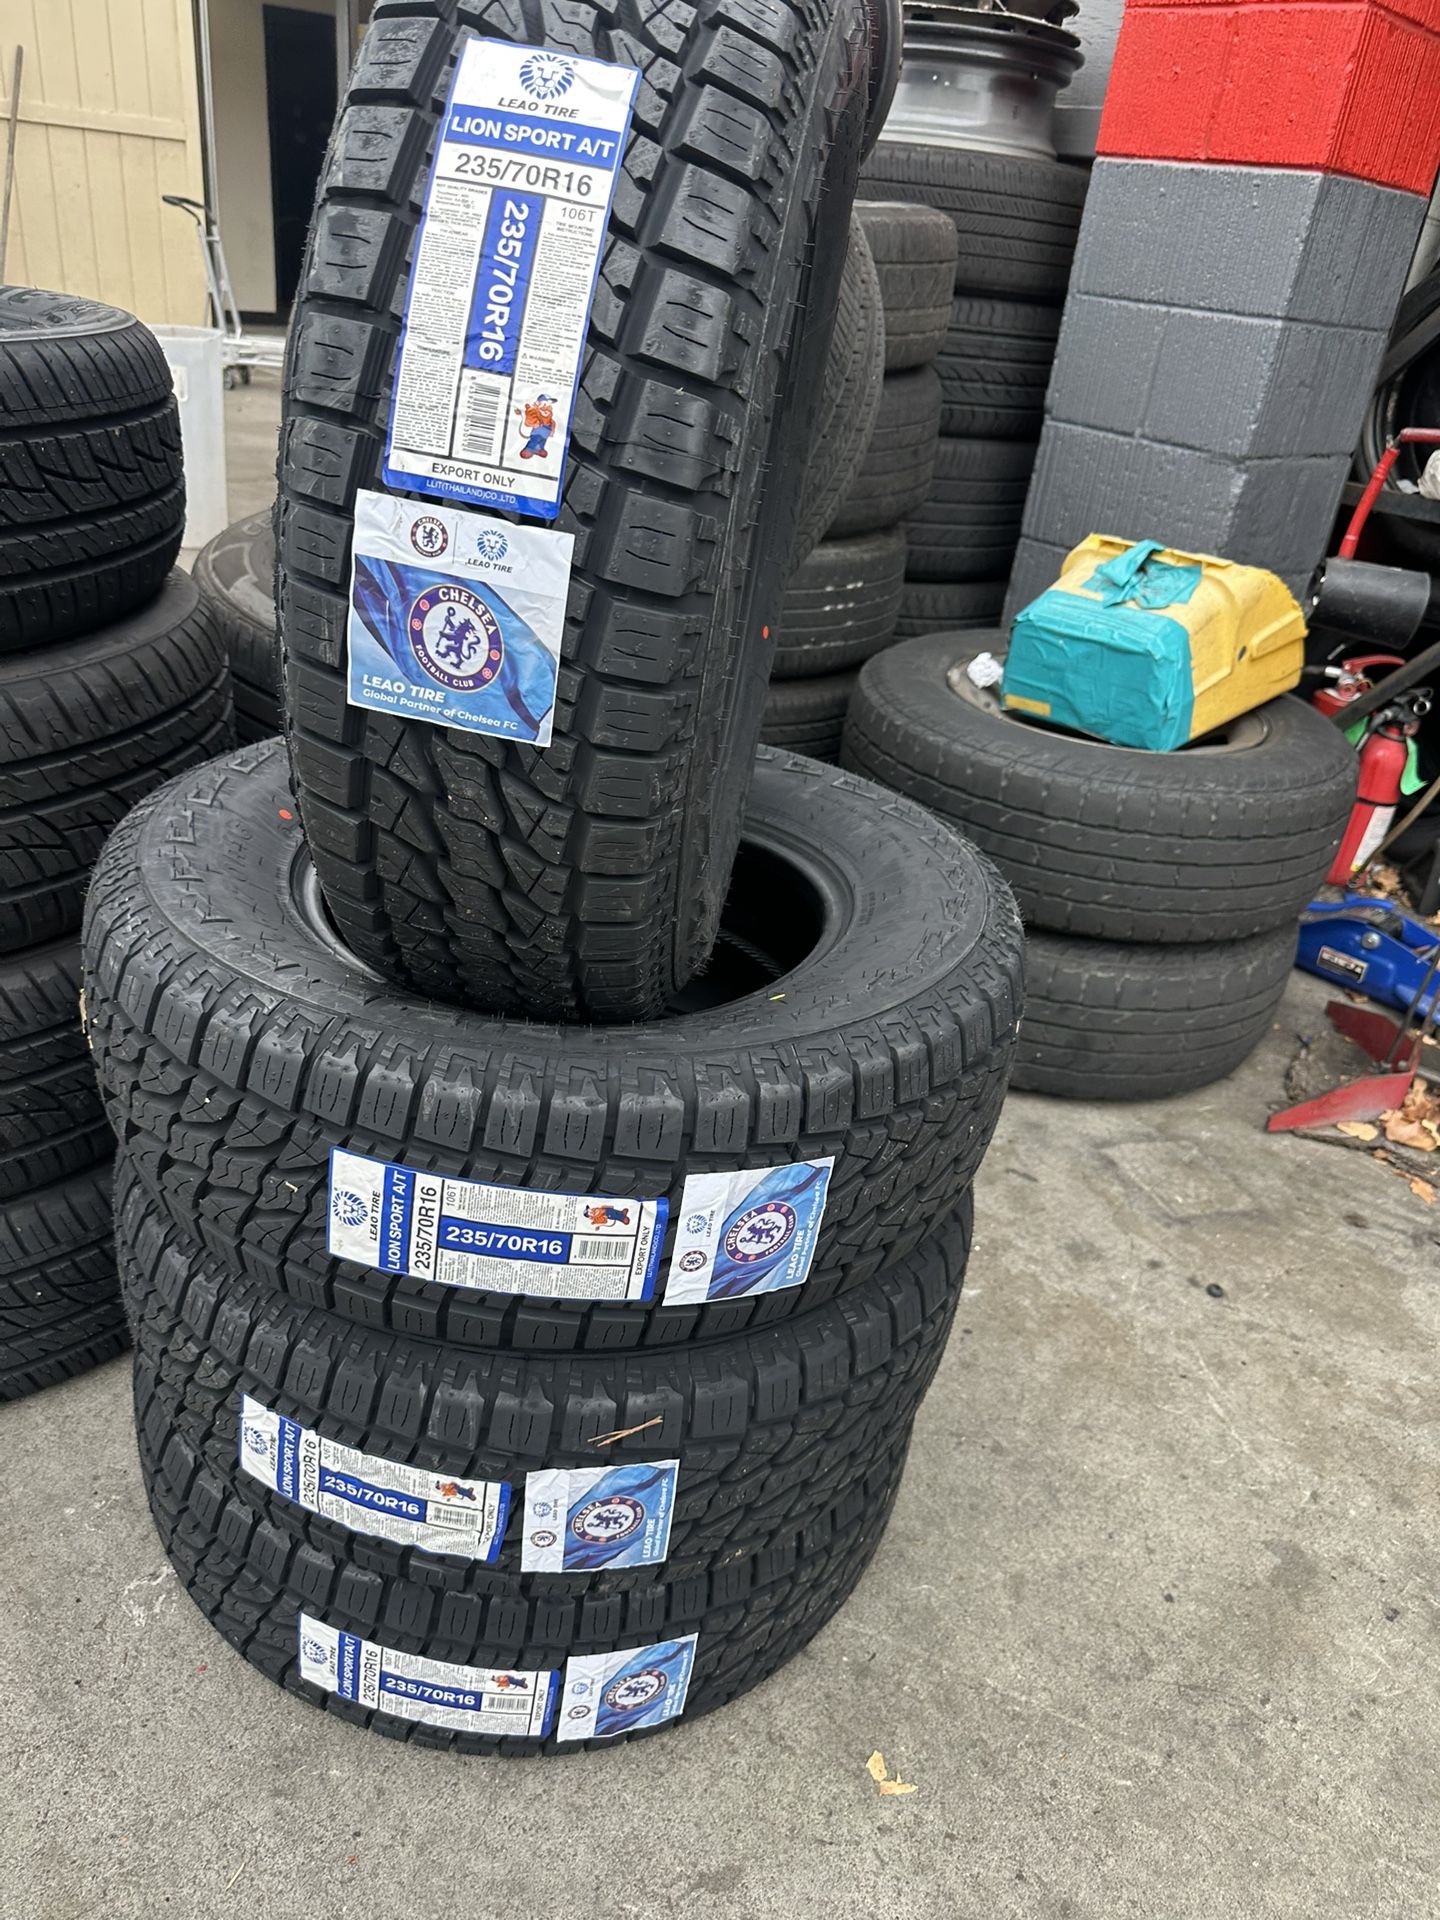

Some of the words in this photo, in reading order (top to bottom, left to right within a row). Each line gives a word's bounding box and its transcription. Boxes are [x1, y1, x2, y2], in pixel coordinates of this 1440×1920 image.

[498, 96, 539, 112] LEAO
[545, 103, 580, 119] TIRE
[451, 115, 502, 140] LION
[502, 123, 577, 152] SPORT
[576, 137, 615, 159] A/T
[454, 152, 593, 197] 235/70R16
[561, 207, 598, 222] 106T
[479, 199, 530, 362] 235/70R16
[431, 462, 480, 482] EXPORT
[483, 472, 516, 489] ONLY
[467, 558, 491, 569] LEAO
[493, 562, 513, 573] TIRE
[438, 588, 496, 636] CHELSEA
[415, 644, 450, 684] FOOTBALL
[452, 678, 475, 688] CLUB
[362, 674, 406, 694] LEAO
[410, 684, 446, 703] TIRE
[362, 688, 398, 705] Global
[399, 697, 441, 716] Partner
[443, 706, 456, 717] of
[456, 710, 501, 728] Chelsea
[503, 720, 519, 731] FC
[392, 1170, 406, 1196] A/T
[446, 1185, 457, 1207] 106T
[815, 1180, 823, 1191] FC
[372, 1190, 381, 1215] TIRE
[708, 1210, 716, 1222] TIRE
[369, 1216, 379, 1242] LEAO
[389, 1195, 404, 1240] SPORT
[414, 1186, 437, 1270] 235/70R16
[727, 1210, 757, 1250] CHELSEA
[446, 1226, 563, 1255] 235/70R16
[635, 1247, 647, 1276] EXPORT
[641, 1226, 651, 1245] ONLY
[792, 1229, 805, 1253] TIRE
[387, 1241, 401, 1270] LION
[786, 1253, 800, 1279] LEAO
[283, 1441, 295, 1474] SPORT
[303, 1438, 317, 1505] 235/70R16
[281, 1474, 293, 1498] LION
[324, 1475, 420, 1515] 235/70R16
[487, 1503, 495, 1519] ONLY
[575, 1501, 601, 1533] CHELSEA
[645, 1518, 656, 1536] TIRE
[642, 1537, 653, 1558] LEAO
[344, 1655, 354, 1680] SPORT
[363, 1649, 378, 1702] 235/70R16
[385, 1677, 475, 1705] 235/70R16
